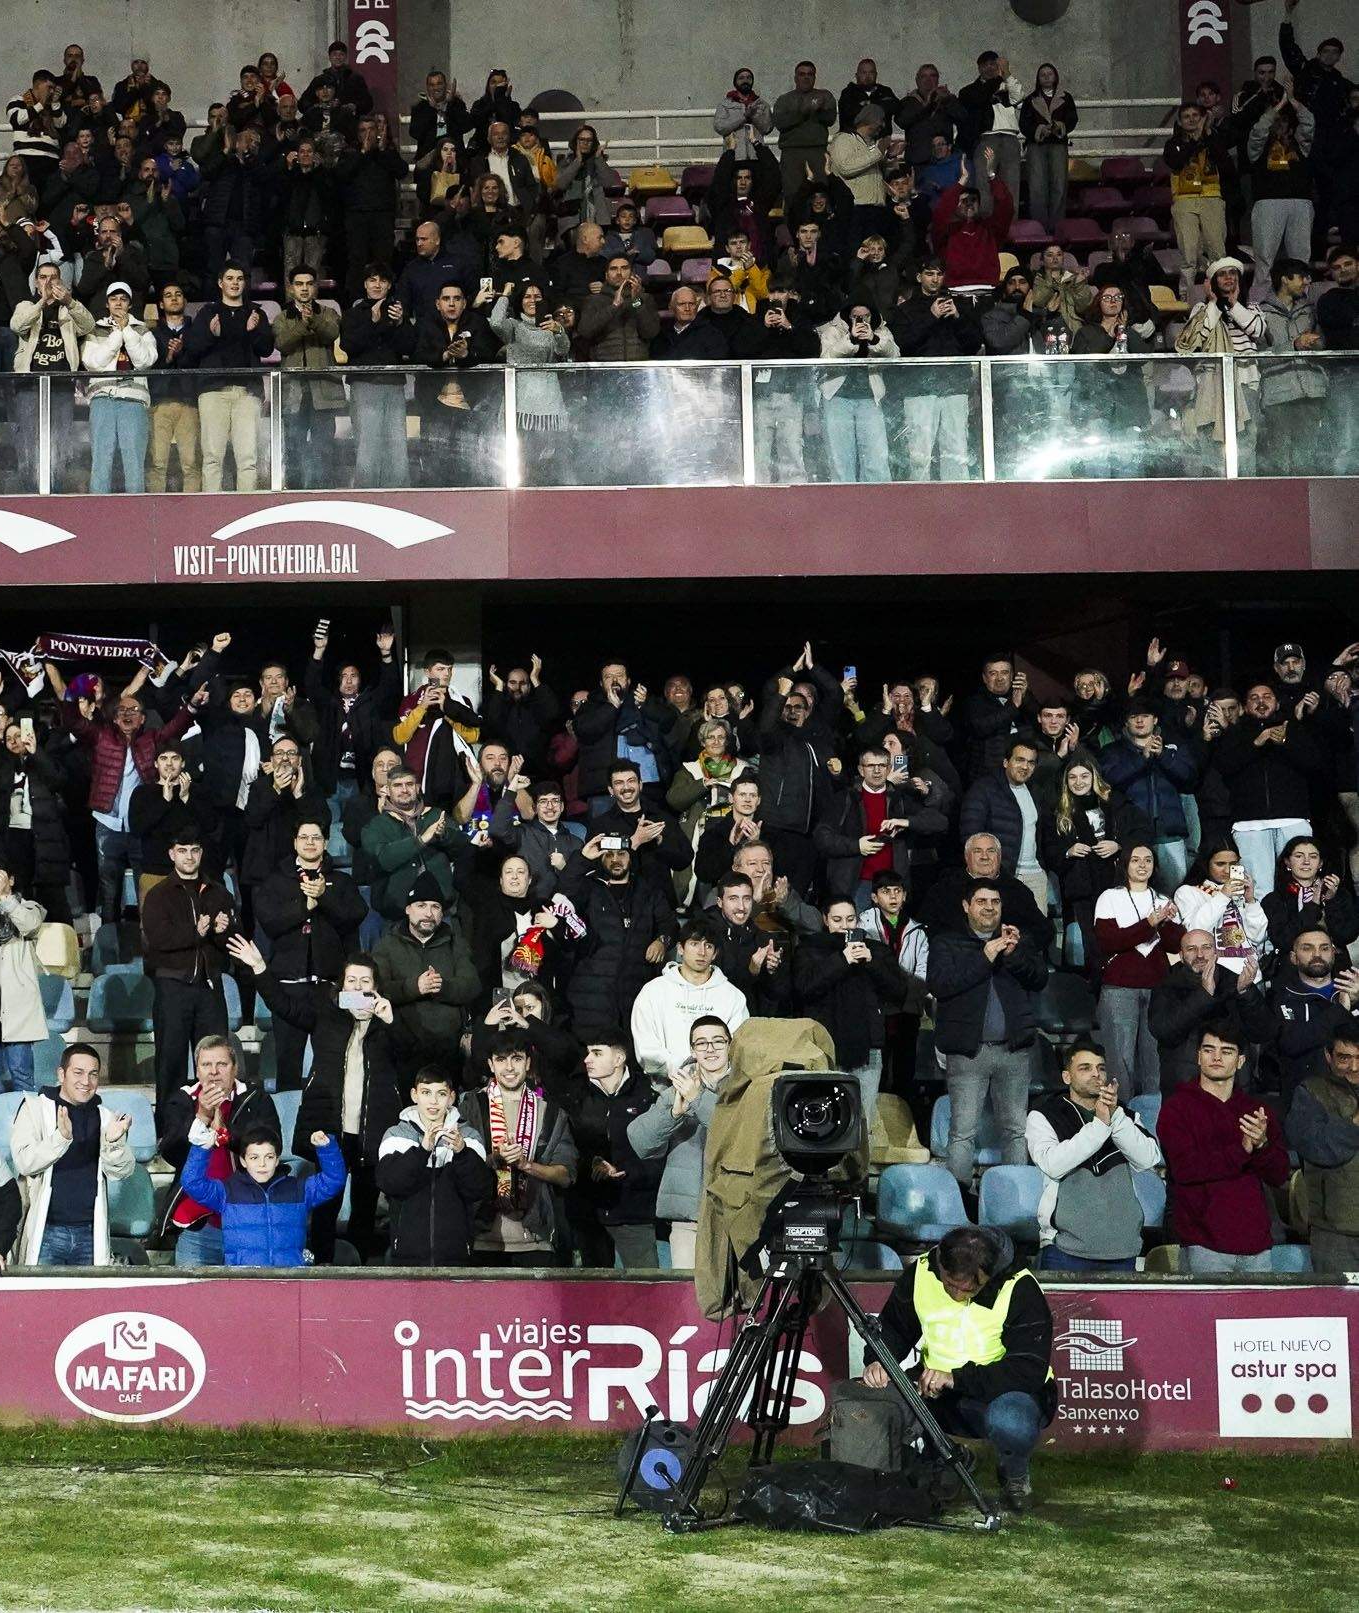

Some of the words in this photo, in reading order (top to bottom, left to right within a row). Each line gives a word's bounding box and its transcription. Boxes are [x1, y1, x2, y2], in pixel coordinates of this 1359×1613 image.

[33, 351, 65, 366] again
[173, 543, 359, 576] VISIT-PONTEVEDRA.GAL
[50, 639, 140, 657] PONTEVEDRA
[496, 1317, 581, 1350] viajes
[1234, 1340, 1276, 1352] HOTEL
[1281, 1339, 1332, 1352] NUEVO
[75, 1366, 186, 1392] MAFARI
[1231, 1360, 1286, 1378] astur
[1294, 1362, 1337, 1382] spa
[118, 1392, 142, 1403] CAFÉ
[1057, 1377, 1192, 1401] TalasoHotel
[1057, 1404, 1140, 1421] Sanxenxo
